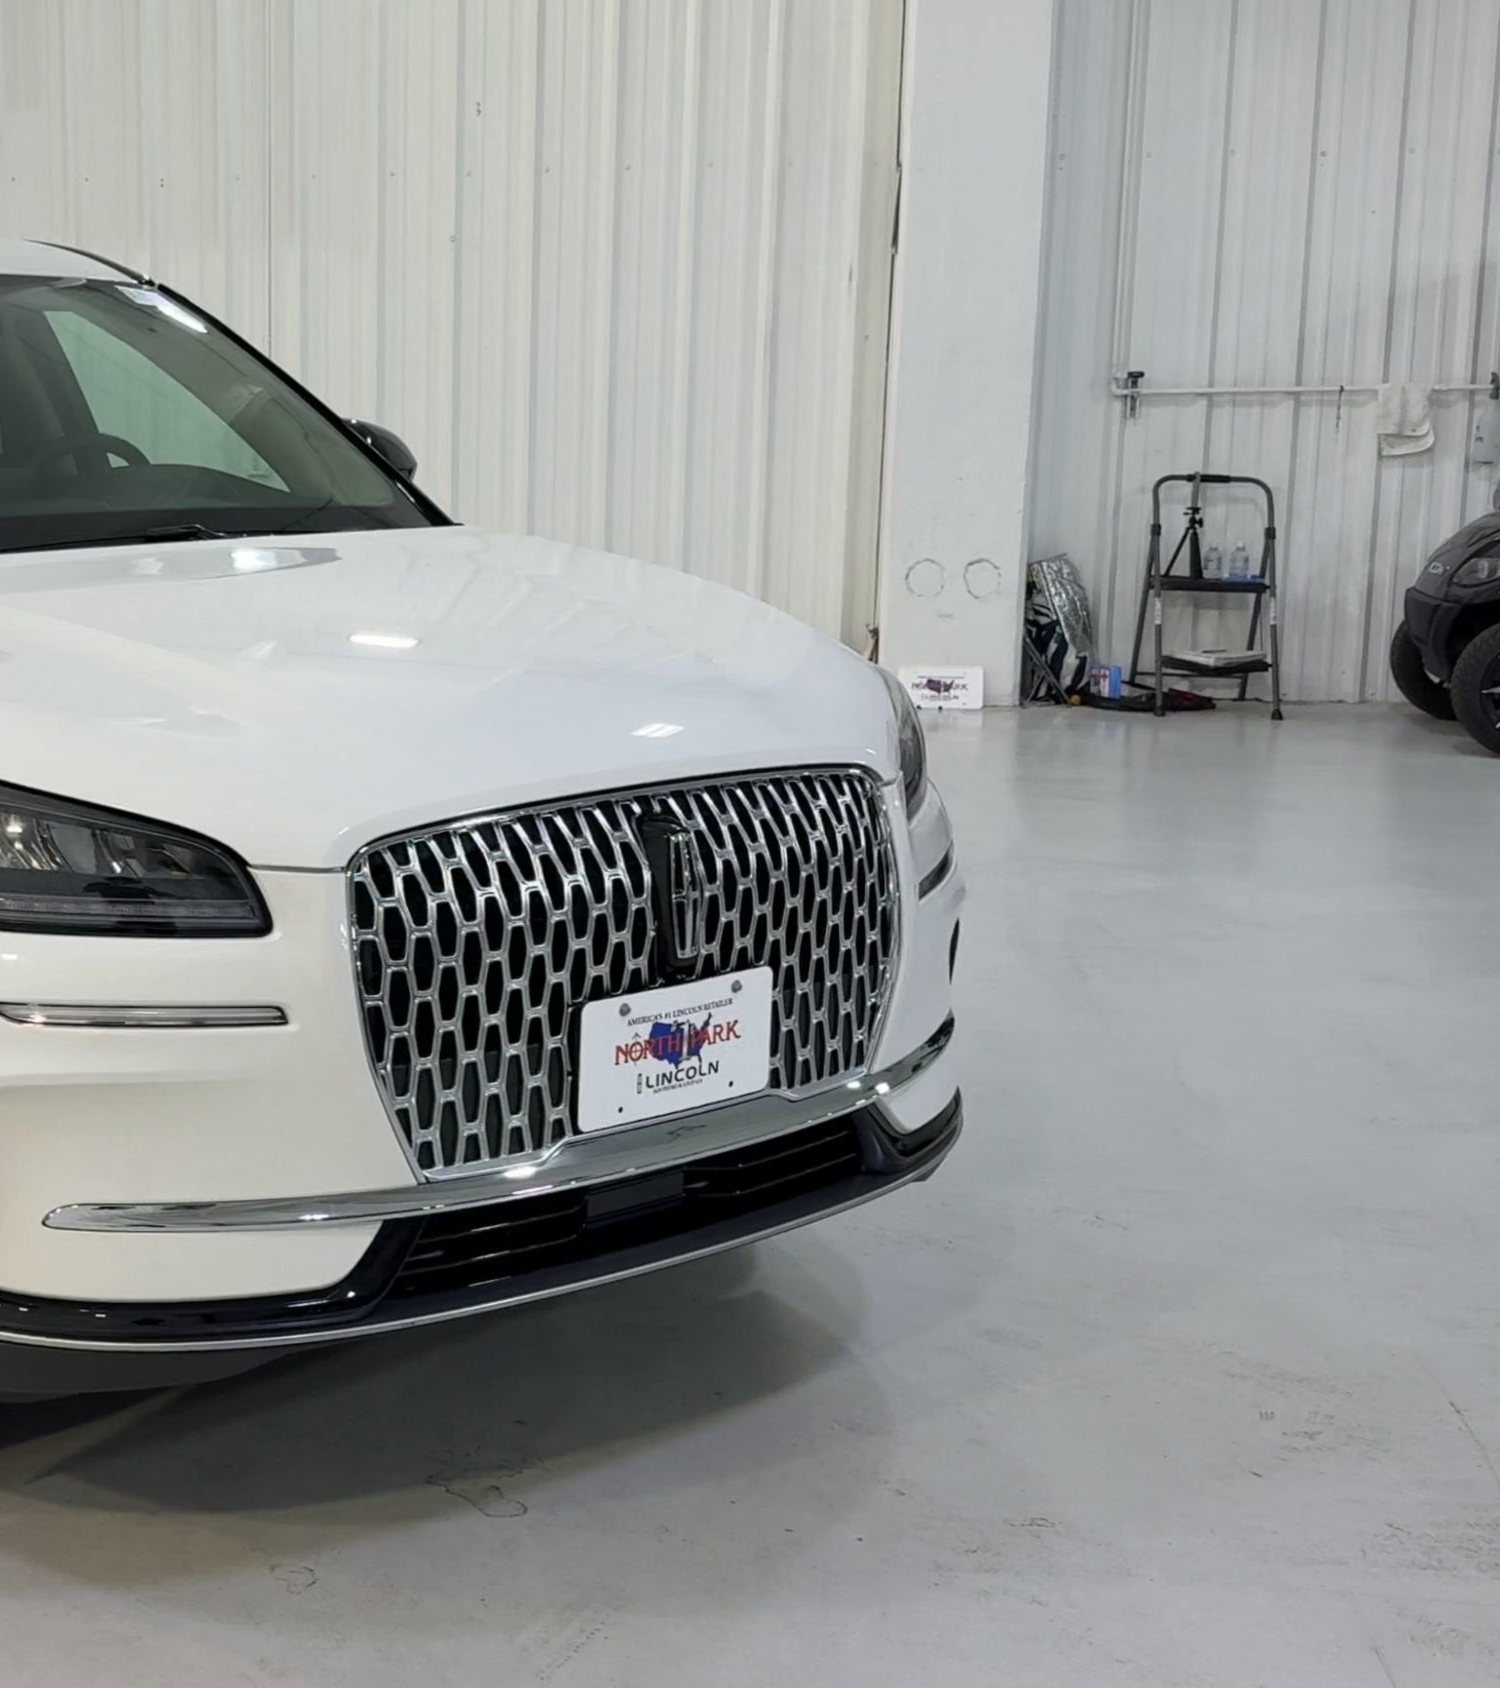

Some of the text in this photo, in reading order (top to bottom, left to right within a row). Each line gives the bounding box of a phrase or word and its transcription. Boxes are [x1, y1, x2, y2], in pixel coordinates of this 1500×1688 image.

[627, 1012, 663, 1026] AMERICA'S
[672, 1004, 704, 1018] LINCOLN
[703, 998, 734, 1012] RETAILER
[614, 1019, 741, 1066] NORTH PARK
[645, 1060, 719, 1089] LINCOLN
